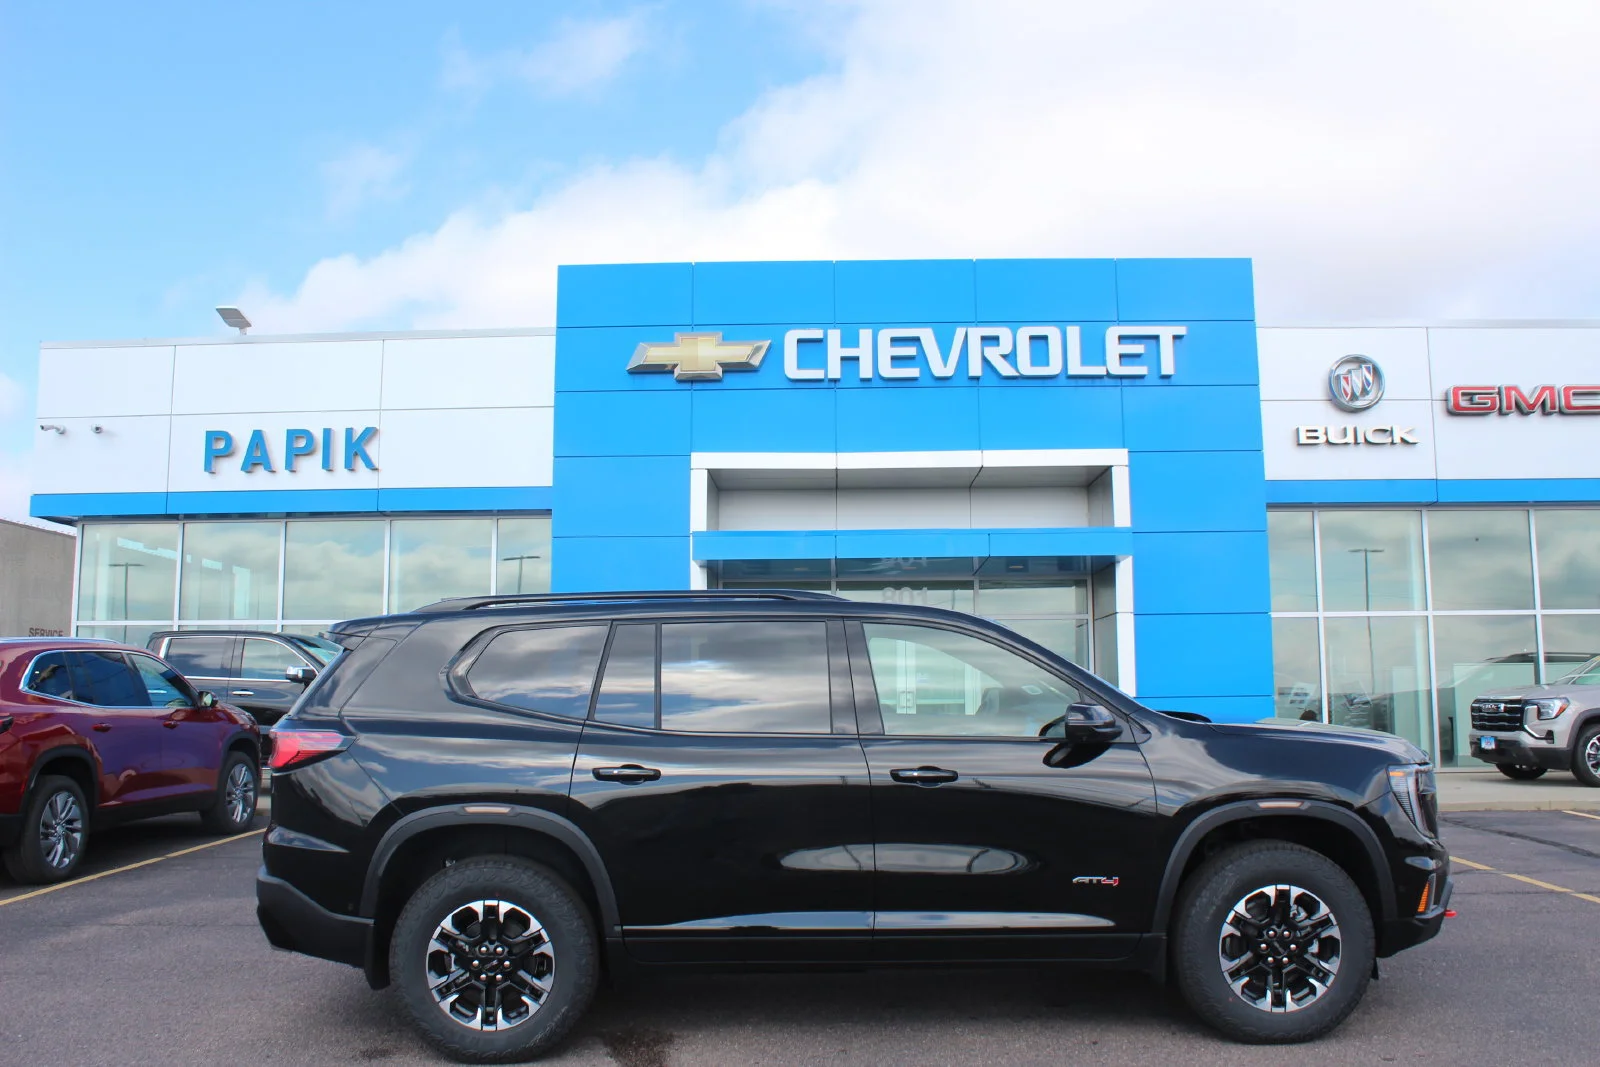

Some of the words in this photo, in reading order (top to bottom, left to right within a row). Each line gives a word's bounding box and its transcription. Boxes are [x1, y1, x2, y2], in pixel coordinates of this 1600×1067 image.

[783, 326, 1187, 381] CHEVROLET
[1446, 384, 1600, 415] GMC
[203, 426, 380, 474] PAPIK
[1296, 425, 1420, 446] BUICK
[1072, 876, 1119, 887] AT4
